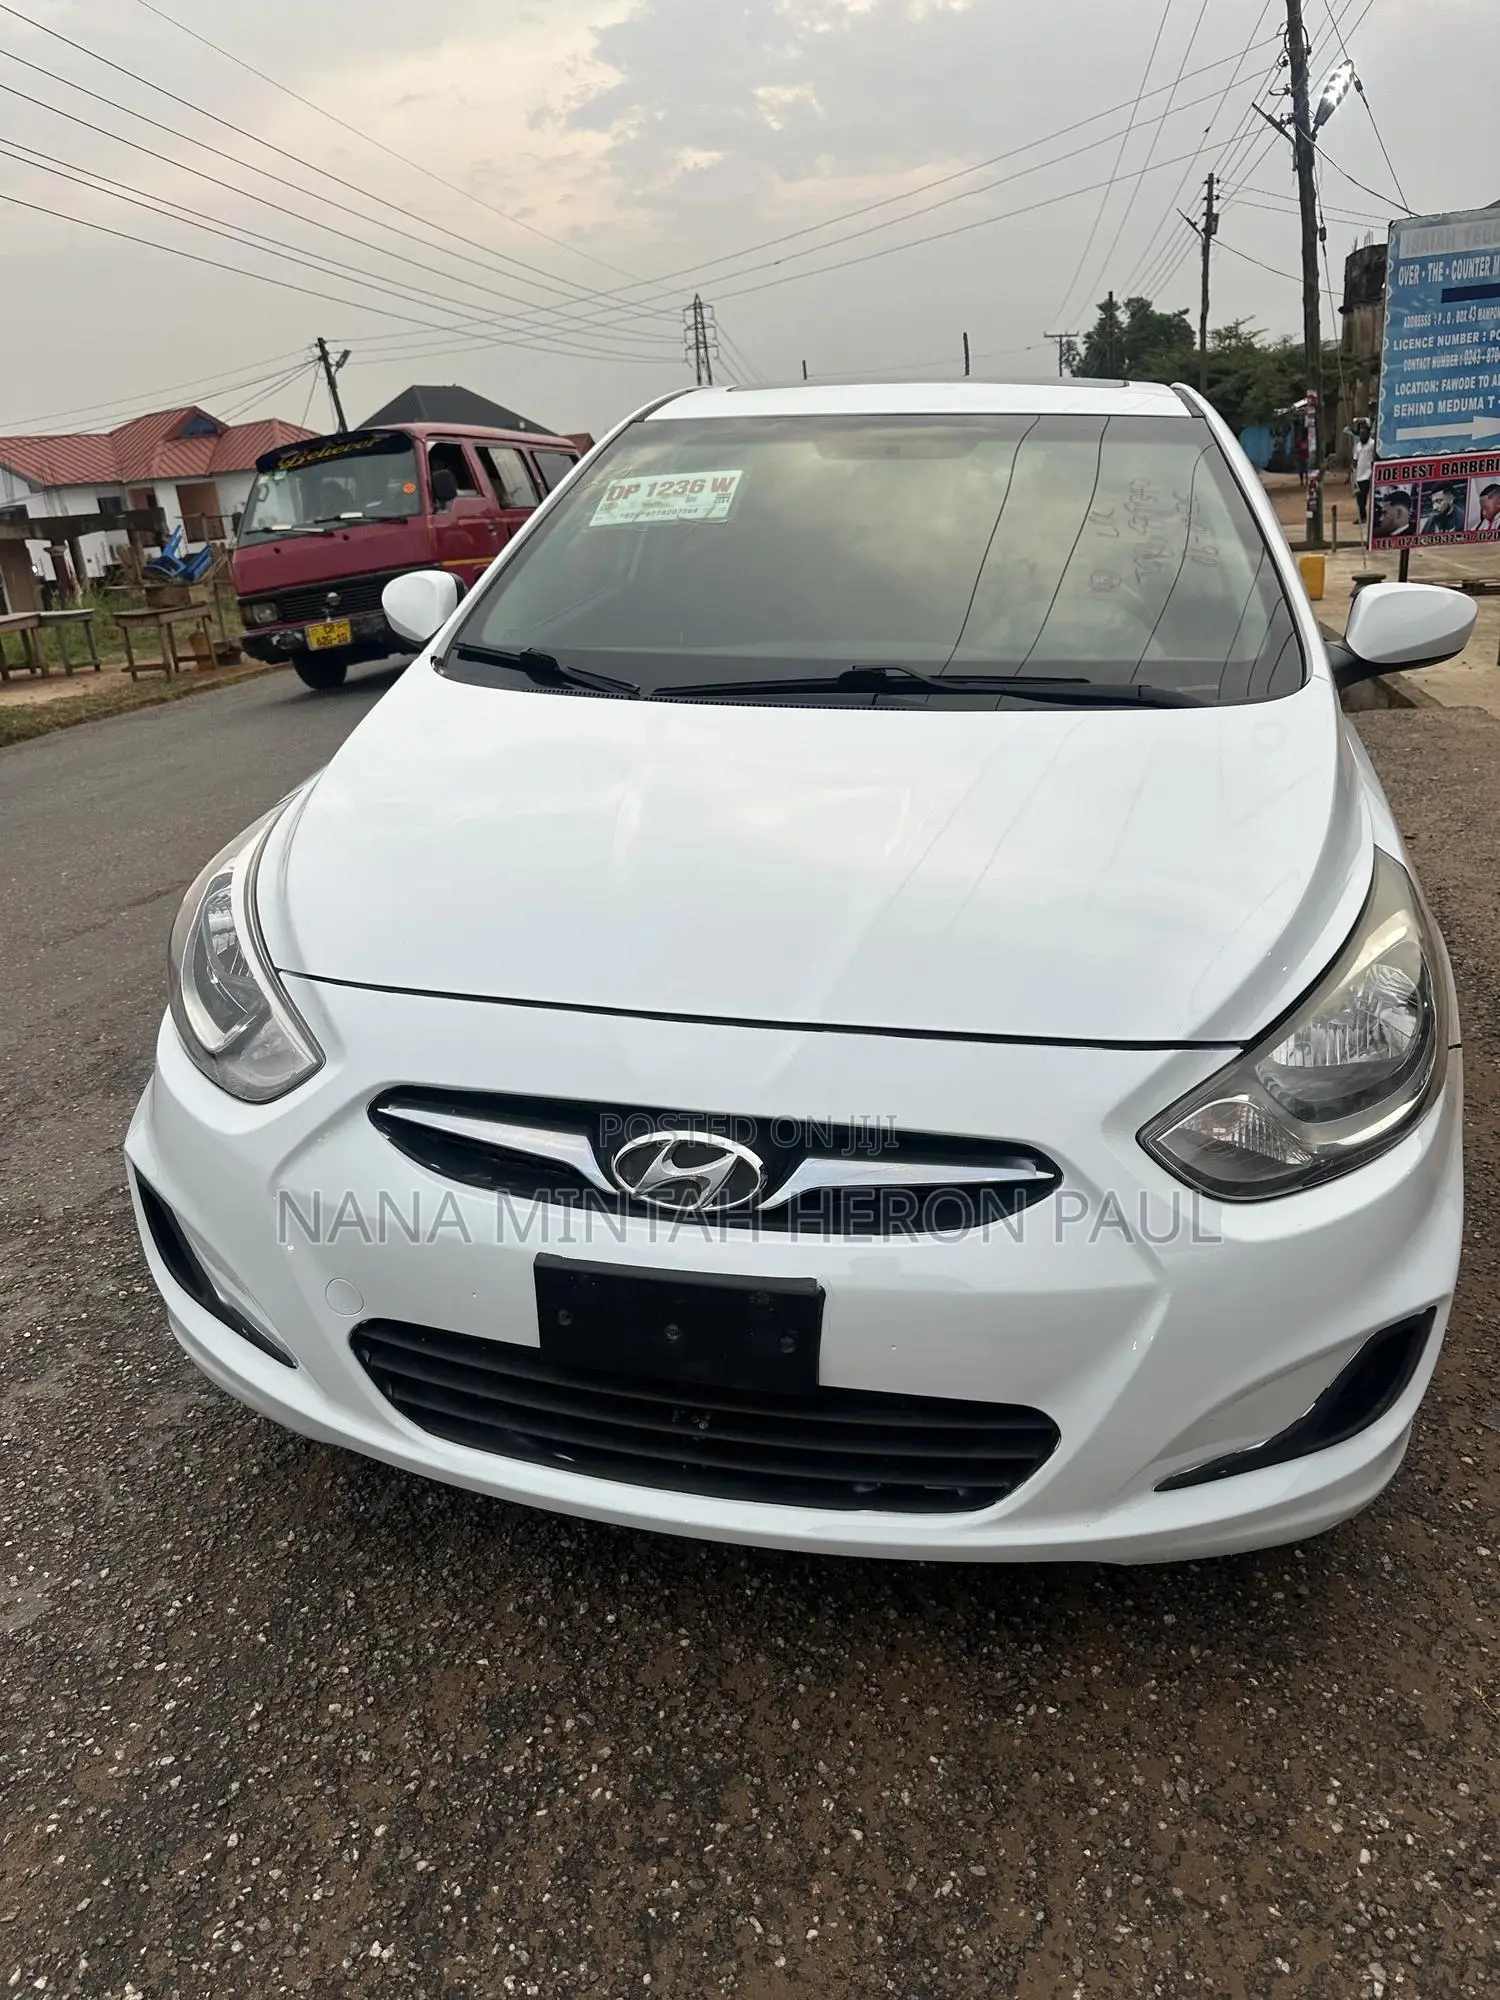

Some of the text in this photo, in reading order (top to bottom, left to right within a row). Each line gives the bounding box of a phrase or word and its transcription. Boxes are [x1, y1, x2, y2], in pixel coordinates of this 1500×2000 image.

[1398, 264, 1420, 286] OVER
[1427, 261, 1444, 283] THE
[1452, 256, 1490, 280] COUNTER
[1393, 336, 1434, 351] LICENCE
[1437, 332, 1480, 346] NUMBER
[1403, 356, 1430, 372] CONTACT
[1441, 376, 1476, 391] FAWODE
[1478, 374, 1489, 388] TO
[1393, 401, 1434, 417] BEHIND
[1437, 396, 1485, 413] MEDUMA
[1402, 464, 1435, 479] BEST
[606, 483, 642, 502] DP
[647, 479, 706, 498] 1236
[711, 476, 736, 493] W
